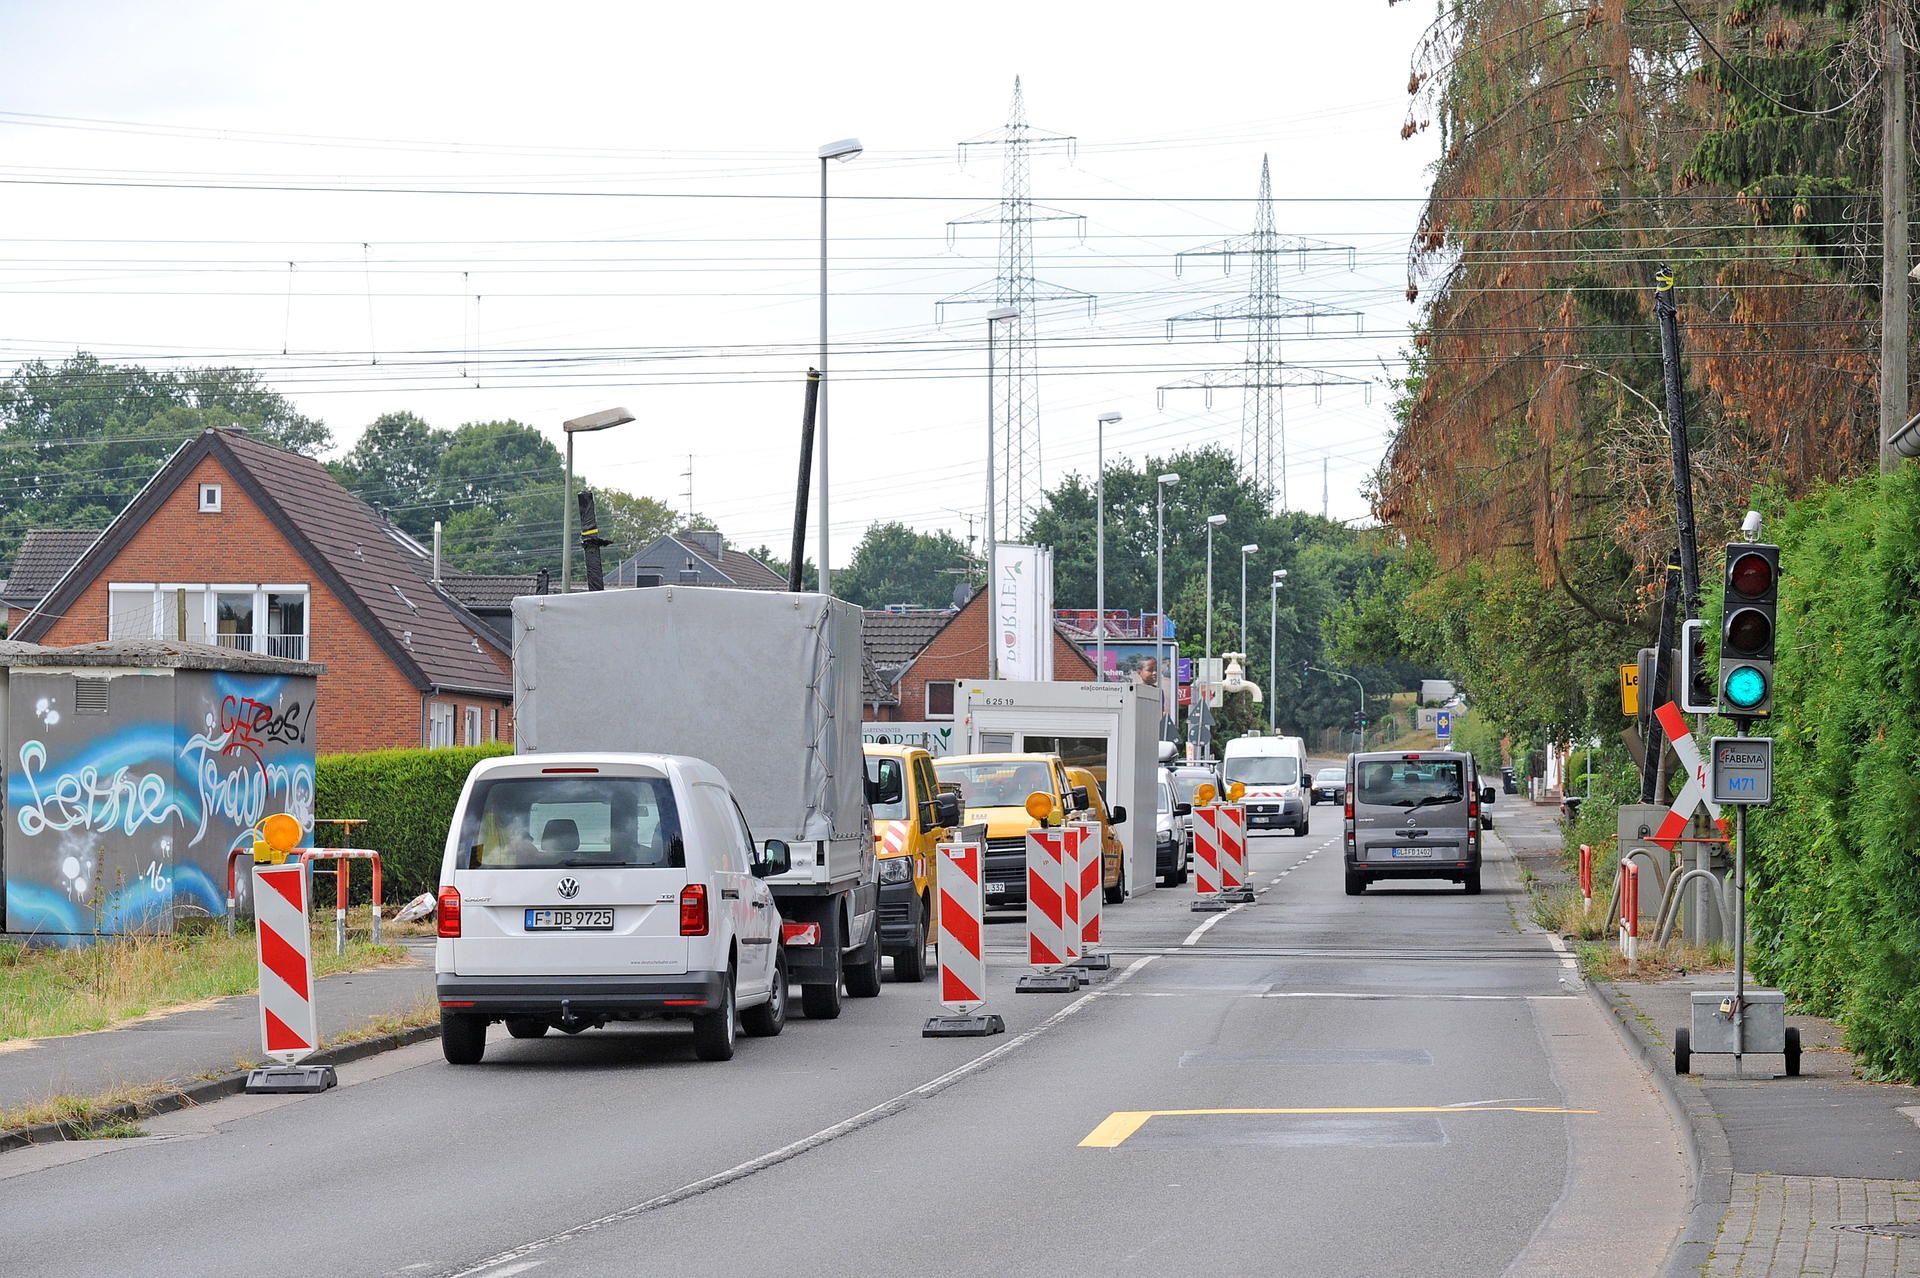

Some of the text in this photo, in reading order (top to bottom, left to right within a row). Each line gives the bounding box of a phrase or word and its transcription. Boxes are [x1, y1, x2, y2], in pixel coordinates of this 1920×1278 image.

[1725, 754, 1763, 764] FABEMA
[1729, 777, 1755, 791] M71
[991, 883, 1004, 892] 332
[535, 911, 612, 926] F DB 9725
